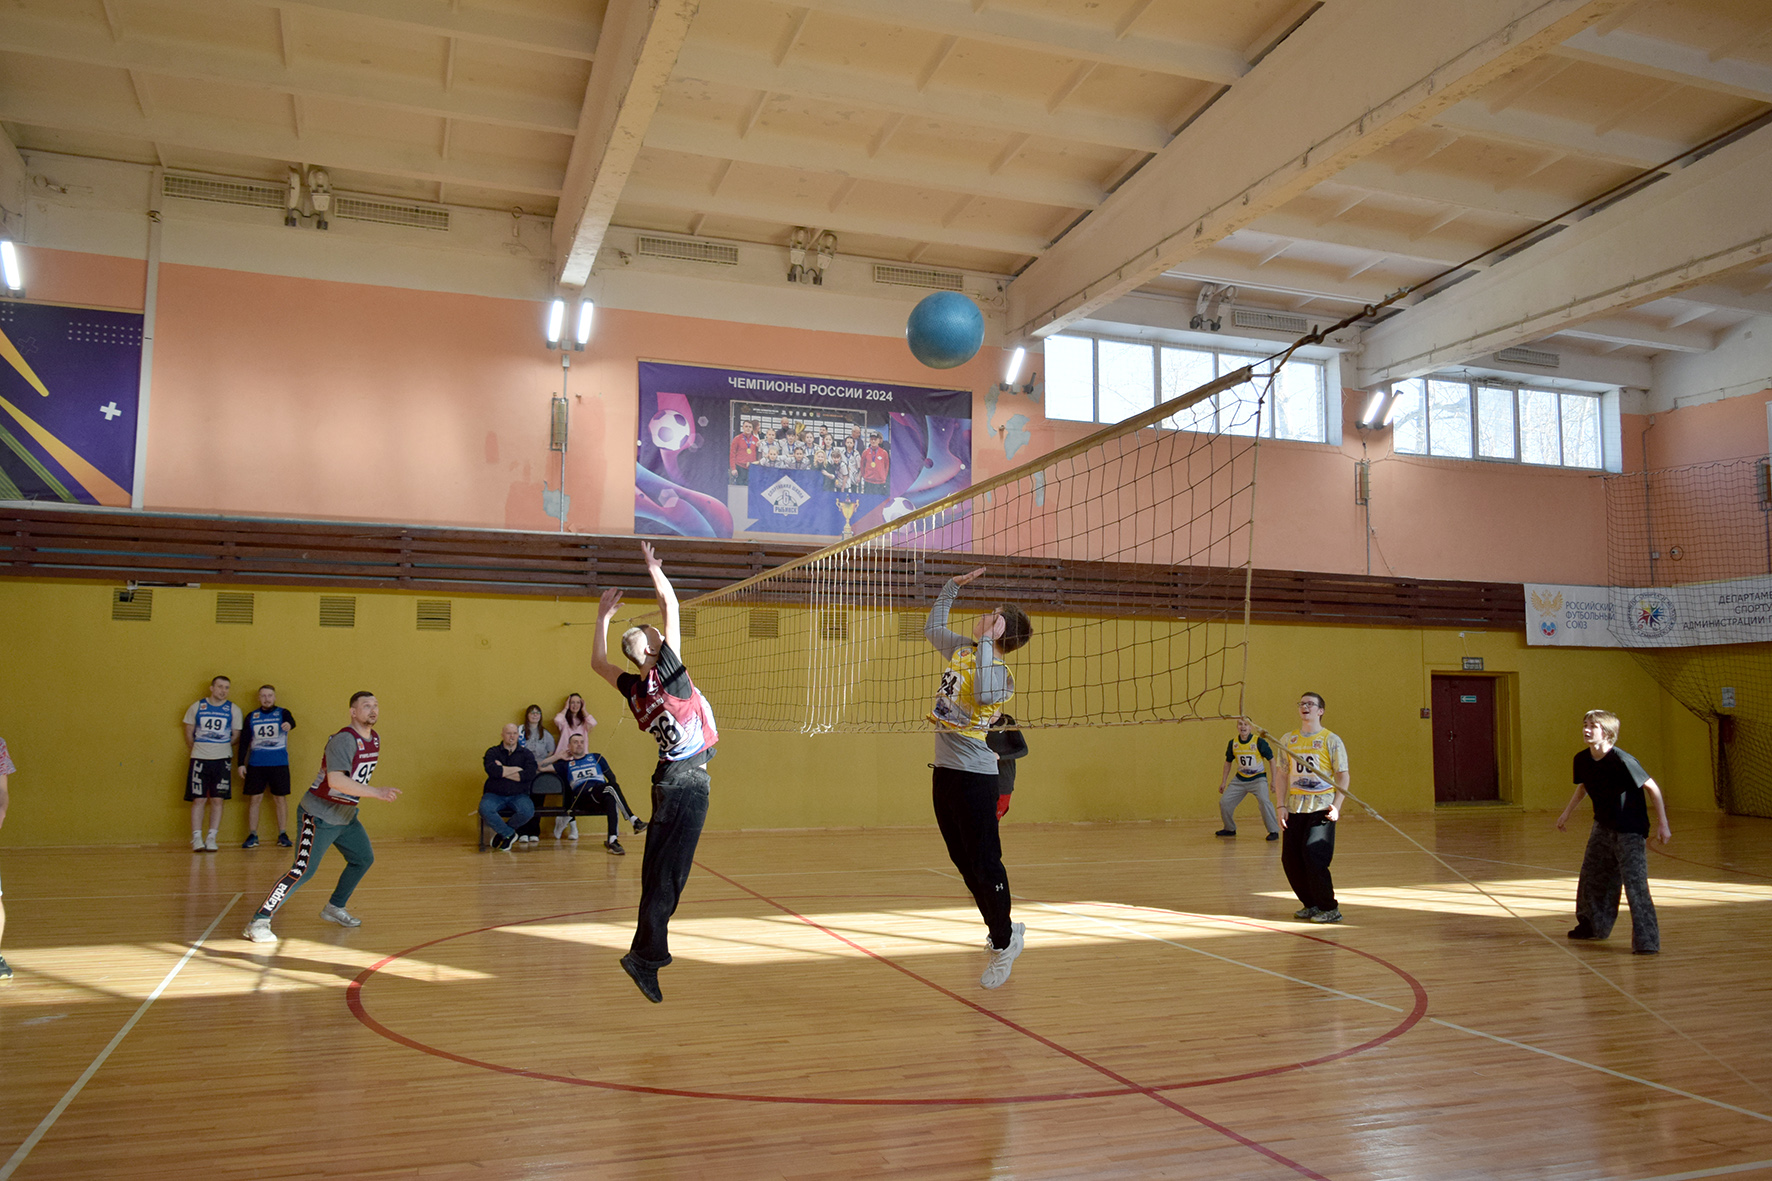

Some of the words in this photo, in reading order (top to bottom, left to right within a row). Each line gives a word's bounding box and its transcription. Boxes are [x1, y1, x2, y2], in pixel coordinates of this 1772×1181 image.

[728, 376, 806, 394] ЧЕМПИОНЫ
[809, 384, 863, 399] РОССИИ
[865, 389, 893, 402] 2024
[1565, 600, 1614, 612] РОССИЙСКИЙ
[1735, 603, 1772, 614] СПОРТУ
[1565, 610, 1616, 621] ФУТБОЛЬНЫЙ
[1565, 620, 1587, 629] СОЮЗ
[1683, 616, 1765, 630] АДМИНИСТРАЦИИ
[204, 718, 222, 731] 49
[258, 725, 275, 738] 43
[649, 716, 682, 750] 96
[1240, 756, 1253, 766] 67
[191, 760, 203, 796] EFC
[355, 763, 377, 784] 95
[577, 769, 594, 779] 45
[263, 883, 288, 912] Kappa
